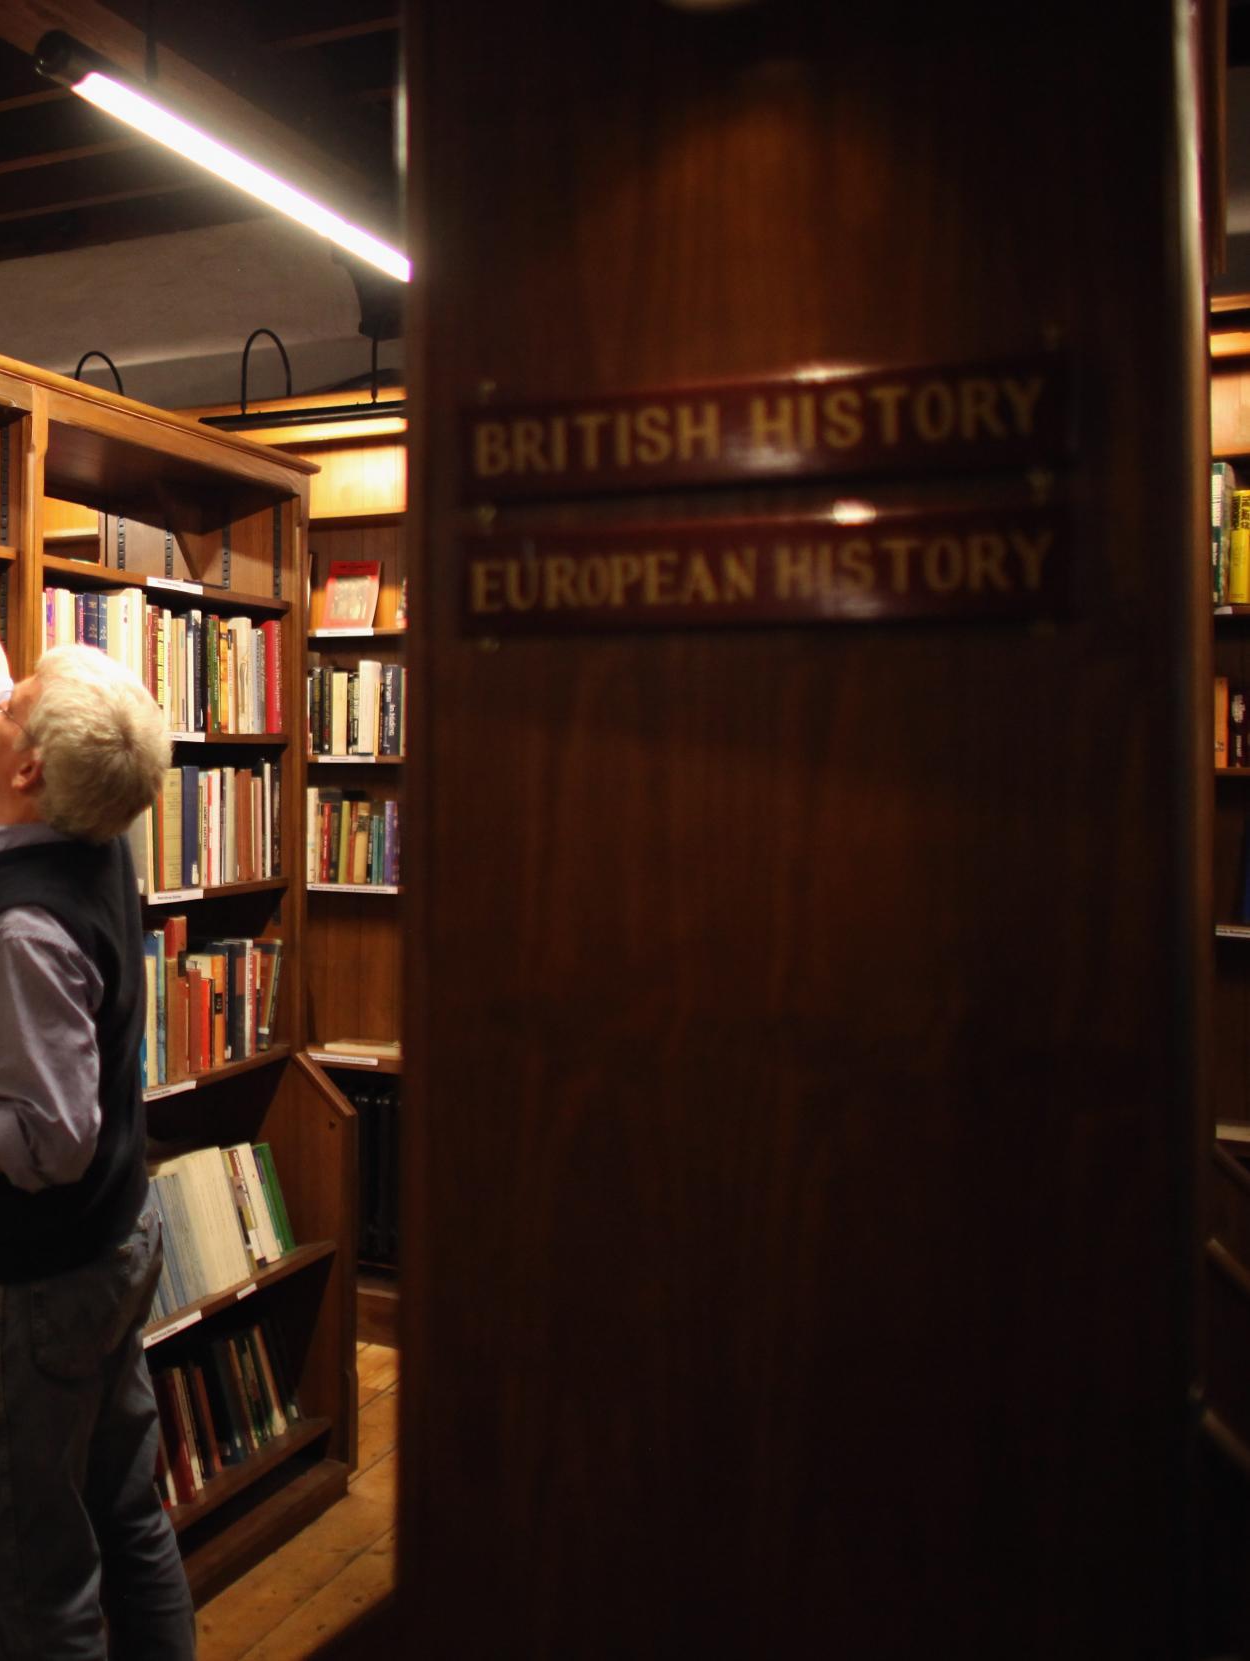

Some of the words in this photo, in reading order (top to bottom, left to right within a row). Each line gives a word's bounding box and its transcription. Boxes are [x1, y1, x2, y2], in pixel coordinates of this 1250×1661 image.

[474, 403, 720, 477] BRITISH
[752, 376, 1044, 450] HISTORY
[471, 547, 757, 614] EUROPEAN
[775, 530, 1055, 601] HISTORY
[388, 712, 396, 737] Hiding
